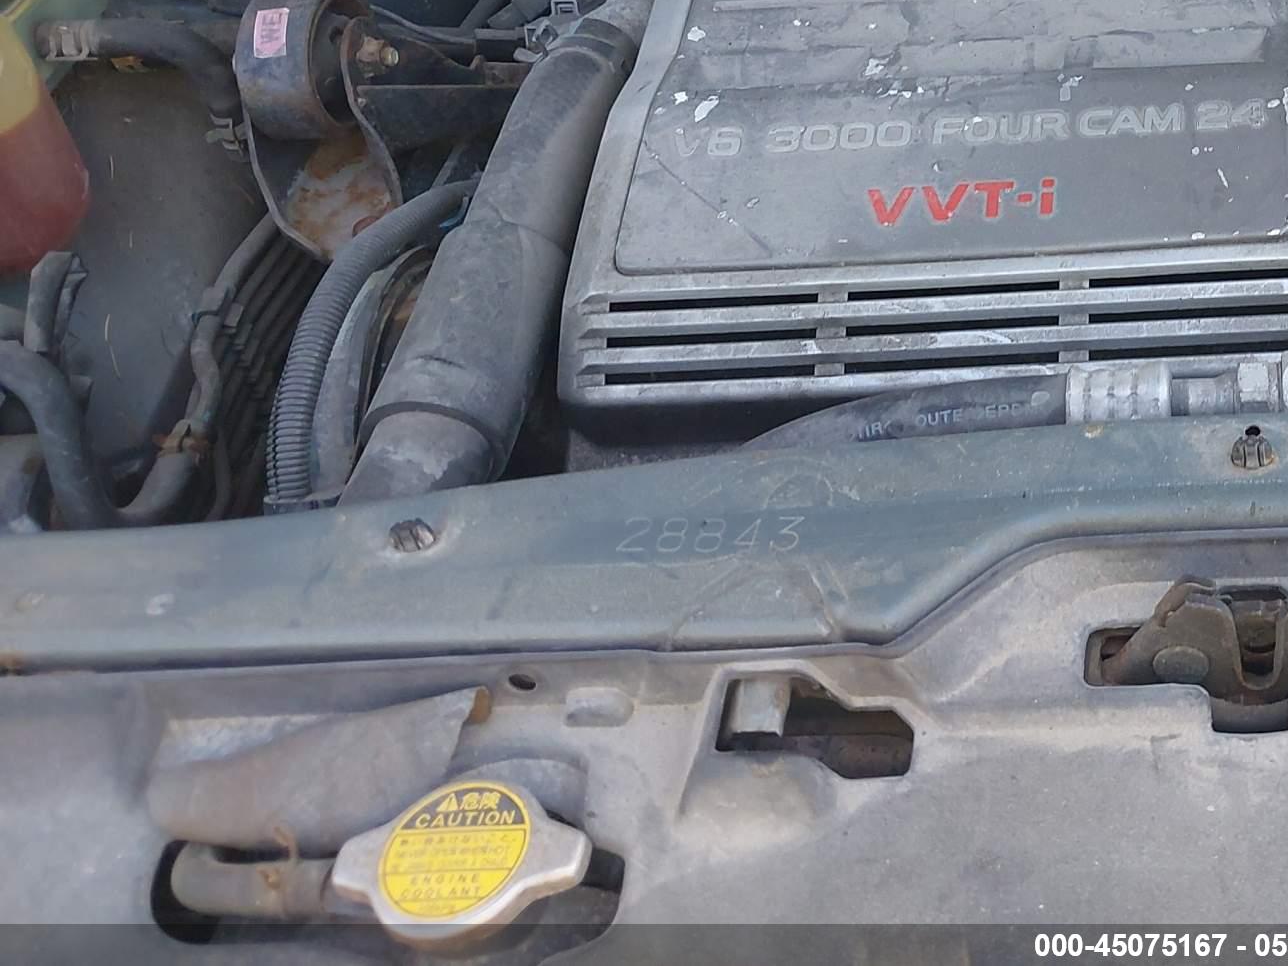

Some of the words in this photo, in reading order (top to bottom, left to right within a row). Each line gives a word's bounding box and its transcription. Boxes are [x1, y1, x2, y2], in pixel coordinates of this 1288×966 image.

[674, 125, 744, 157] V6
[765, 120, 912, 153] 3000
[933, 109, 1069, 144] FOUR
[1079, 102, 1184, 135] CAM
[867, 177, 1056, 227] VVT-i
[616, 516, 805, 553] 28843
[415, 810, 516, 828] CAUTION
[410, 873, 481, 885] ENGINE
